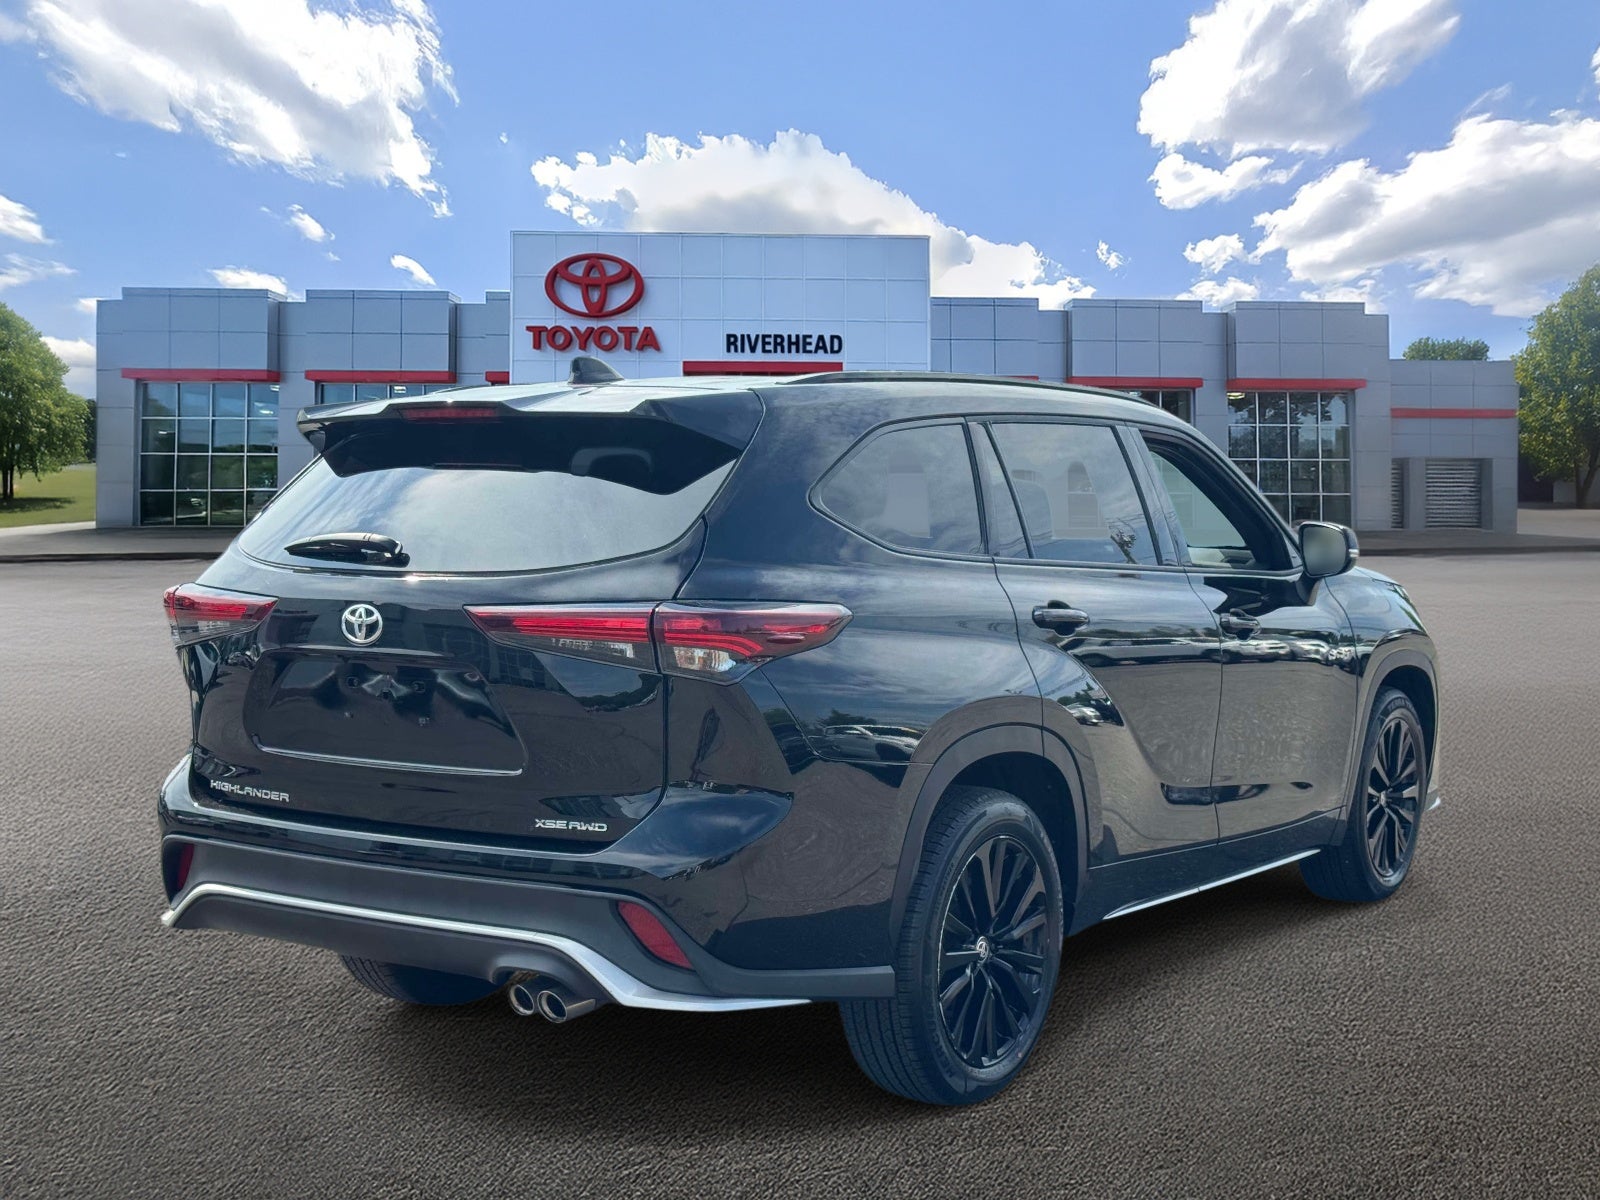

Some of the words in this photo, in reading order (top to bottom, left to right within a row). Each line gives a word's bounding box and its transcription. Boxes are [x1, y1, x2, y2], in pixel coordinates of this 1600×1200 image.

[525, 325, 661, 352] TOYOTA
[725, 333, 843, 355] RIVERHEAD
[210, 780, 289, 802] HIGHLANDER
[535, 819, 567, 829] XSE
[569, 821, 608, 831] RWD
